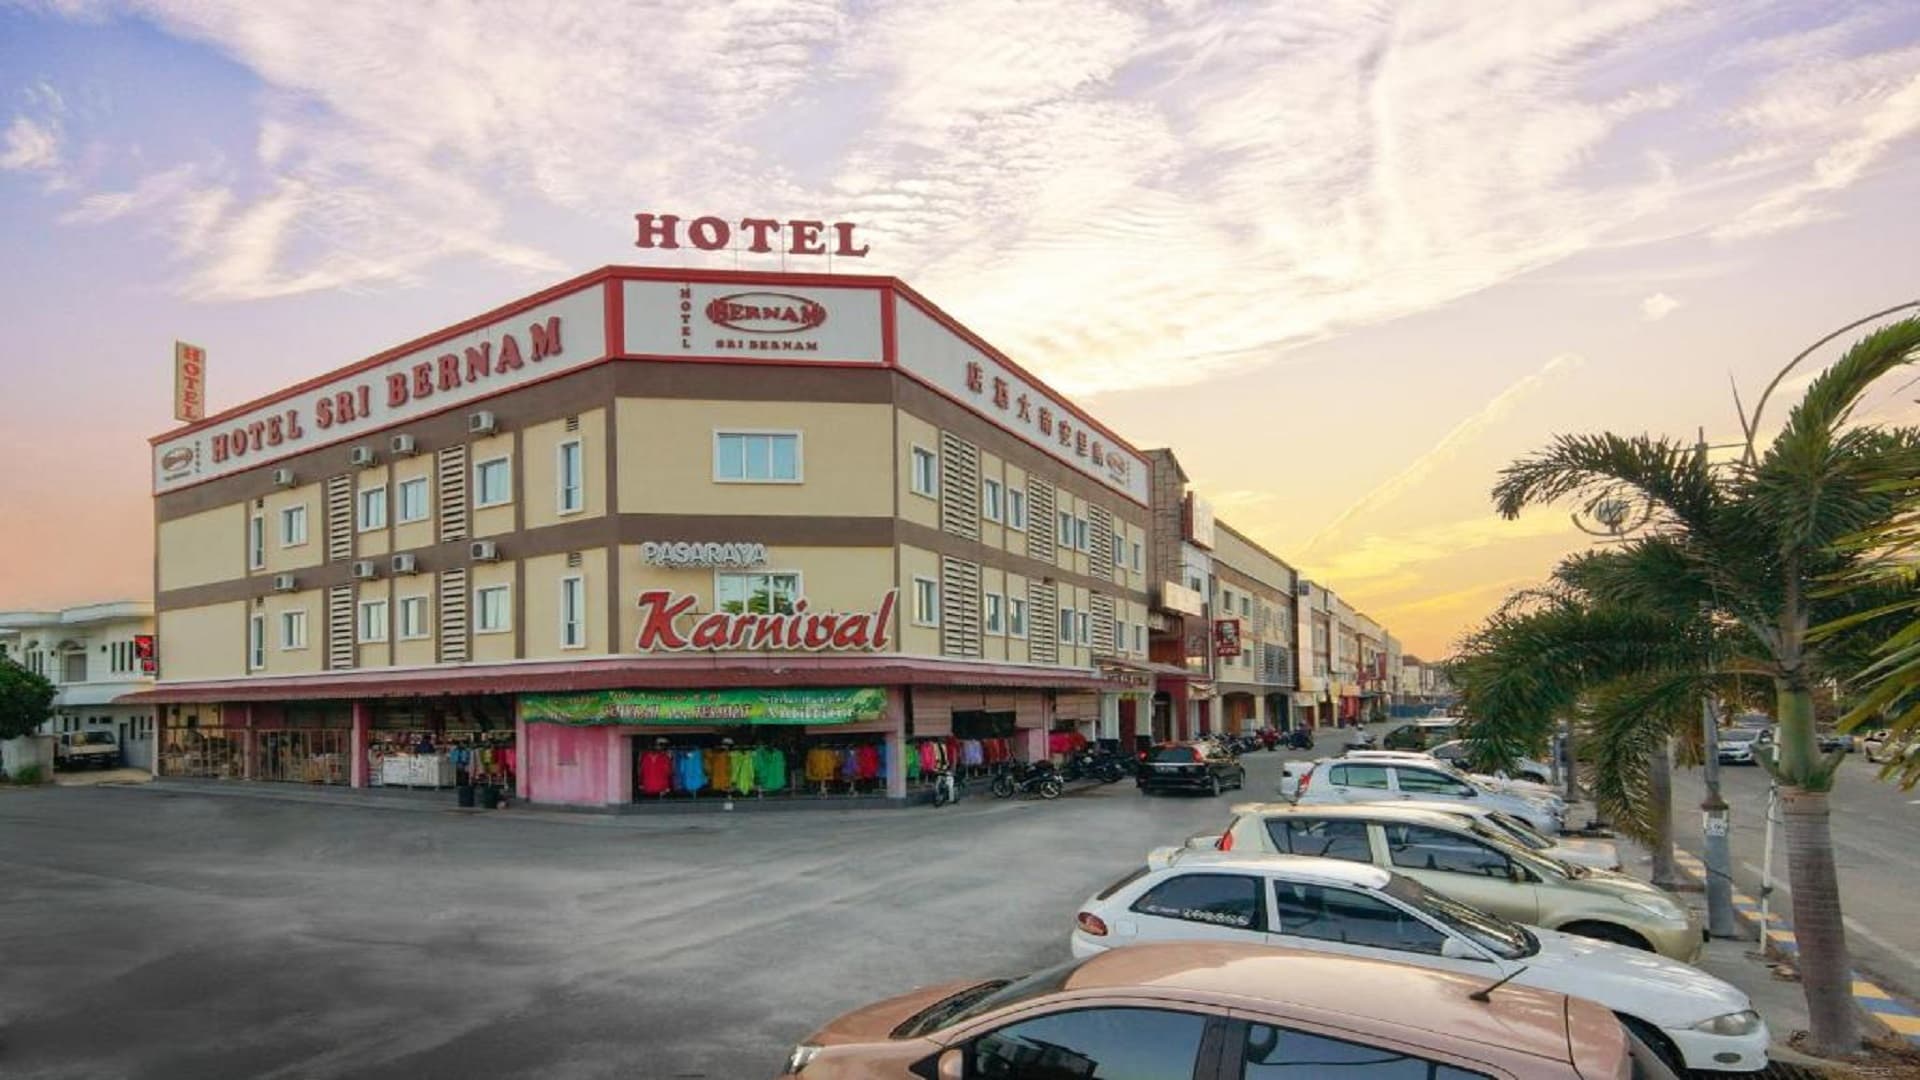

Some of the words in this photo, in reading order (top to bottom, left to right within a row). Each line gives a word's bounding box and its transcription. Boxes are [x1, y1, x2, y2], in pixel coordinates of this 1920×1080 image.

[634, 213, 870, 257] HOTEL
[680, 288, 691, 348] HOTEL
[710, 298, 824, 328] BERNAM
[715, 339, 744, 350] SRI
[749, 340, 818, 351] BERNAM
[183, 346, 200, 419] HOTEL
[210, 408, 303, 464] HOTEL
[316, 385, 370, 430] SRI
[386, 315, 563, 408] BERNAM
[642, 541, 767, 568] PASARAYA
[636, 588, 898, 650] Karnival
